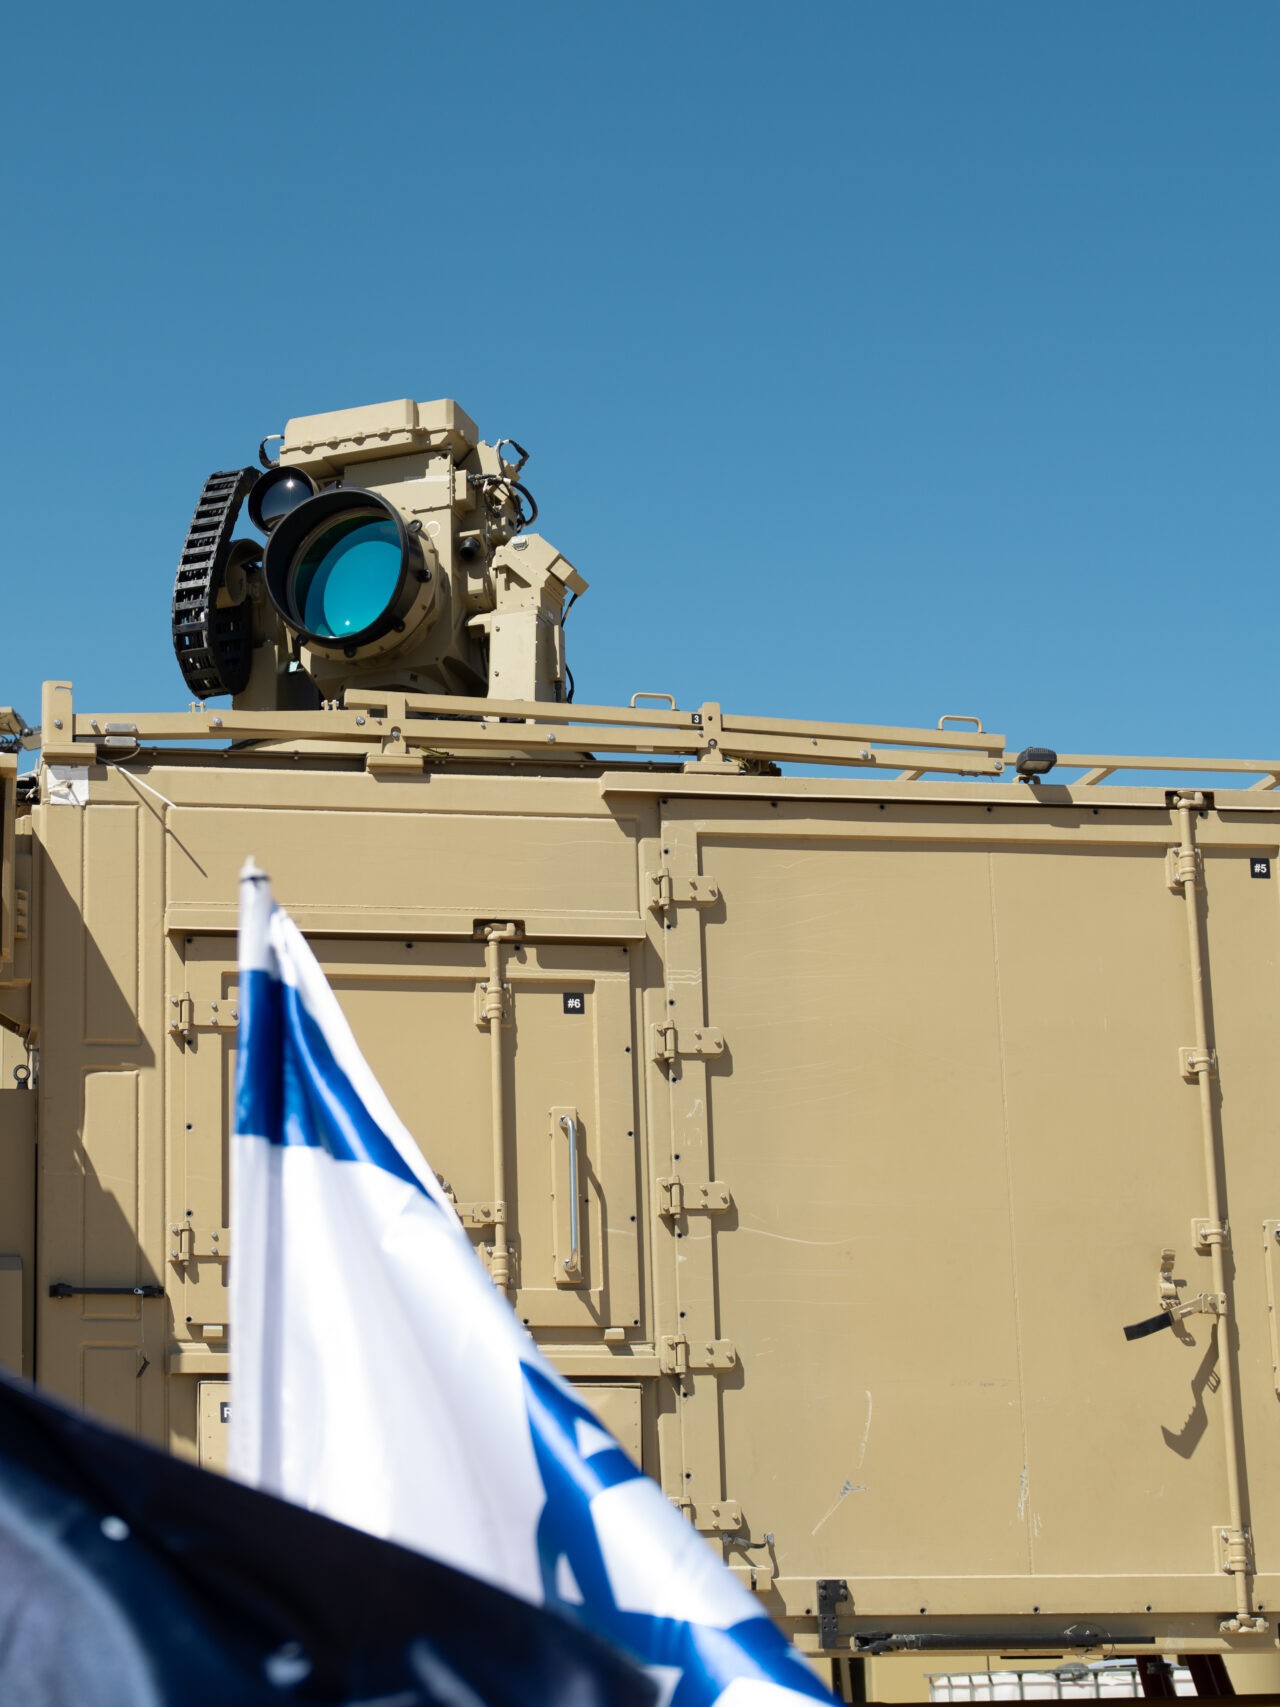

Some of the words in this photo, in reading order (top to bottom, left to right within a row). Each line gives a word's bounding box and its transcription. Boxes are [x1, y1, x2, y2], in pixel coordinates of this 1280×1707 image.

[694, 714, 700, 723] 3
[1254, 863, 1267, 873] #5
[567, 998, 581, 1009] #6
